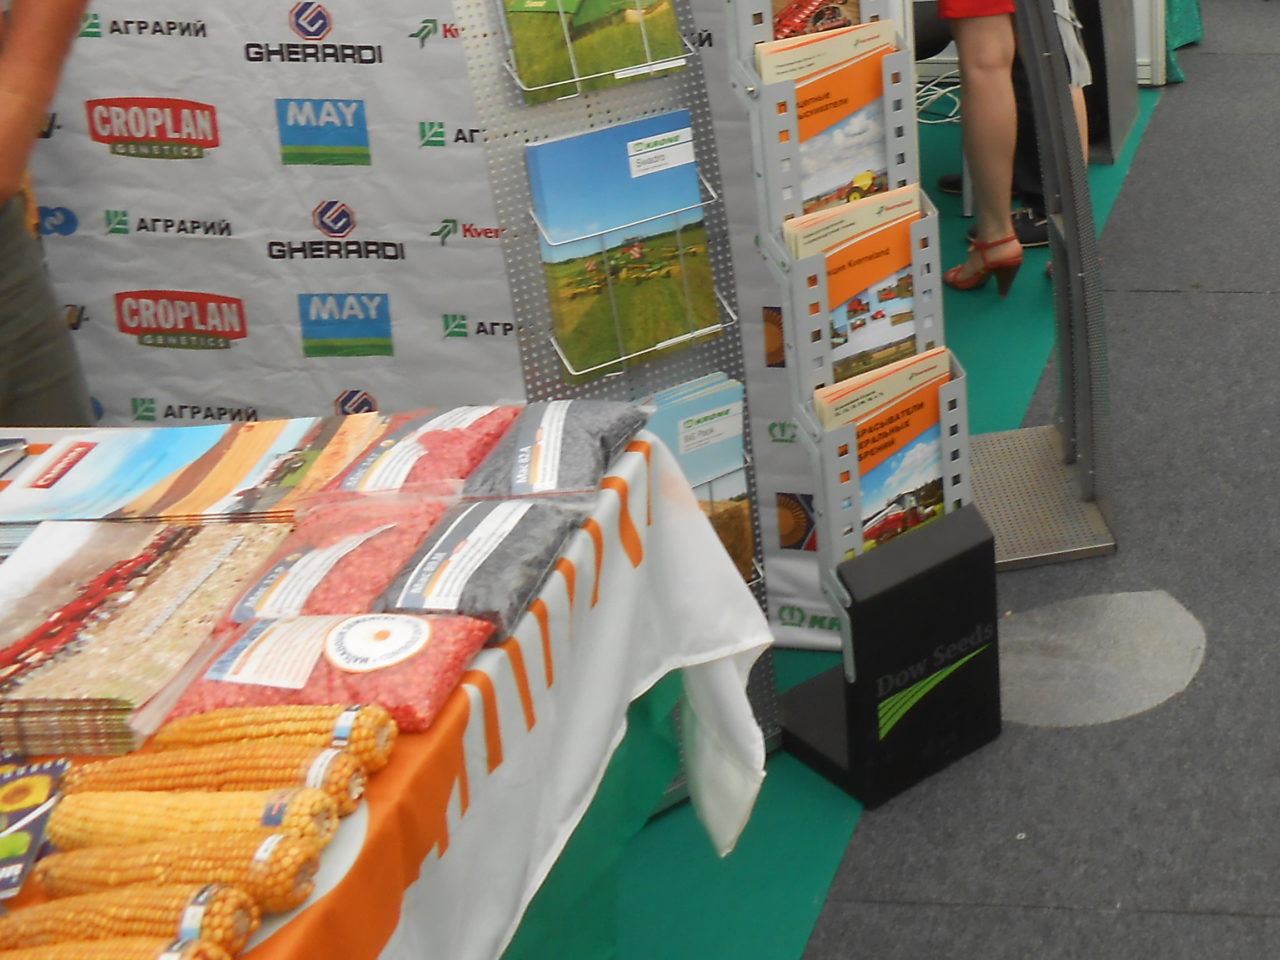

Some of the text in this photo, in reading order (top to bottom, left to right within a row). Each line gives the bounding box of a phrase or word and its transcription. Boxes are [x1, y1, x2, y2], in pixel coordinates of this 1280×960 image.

[109, 17, 206, 37] АГРАРИЙ
[245, 43, 382, 64] GHERARDI
[92, 105, 213, 141] CROPLAN
[287, 101, 359, 127] MAY
[116, 144, 199, 158] GENETICS
[136, 216, 232, 237] АГРАРИЙ
[267, 241, 406, 261] GHERARDI
[122, 297, 241, 332] CROPLAN
[309, 295, 382, 321] MAY
[144, 334, 226, 349] GENETICS
[163, 404, 259, 422] АГРАРИЙ
